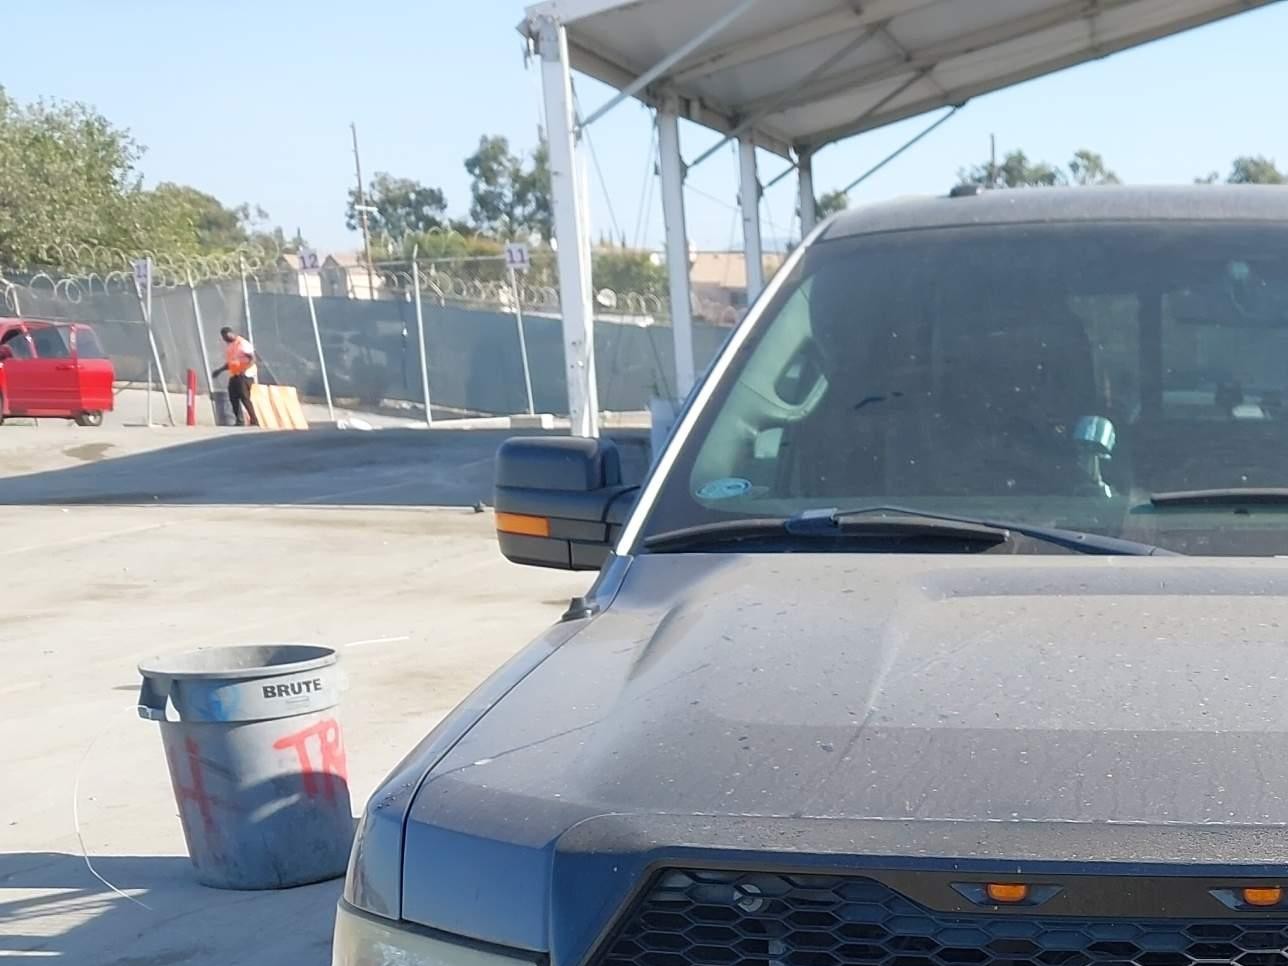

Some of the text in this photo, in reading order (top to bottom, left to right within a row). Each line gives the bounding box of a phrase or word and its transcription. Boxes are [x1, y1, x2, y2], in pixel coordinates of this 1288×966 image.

[300, 252, 319, 270] 12
[506, 247, 526, 265] 11
[262, 678, 322, 698] BRUTE
